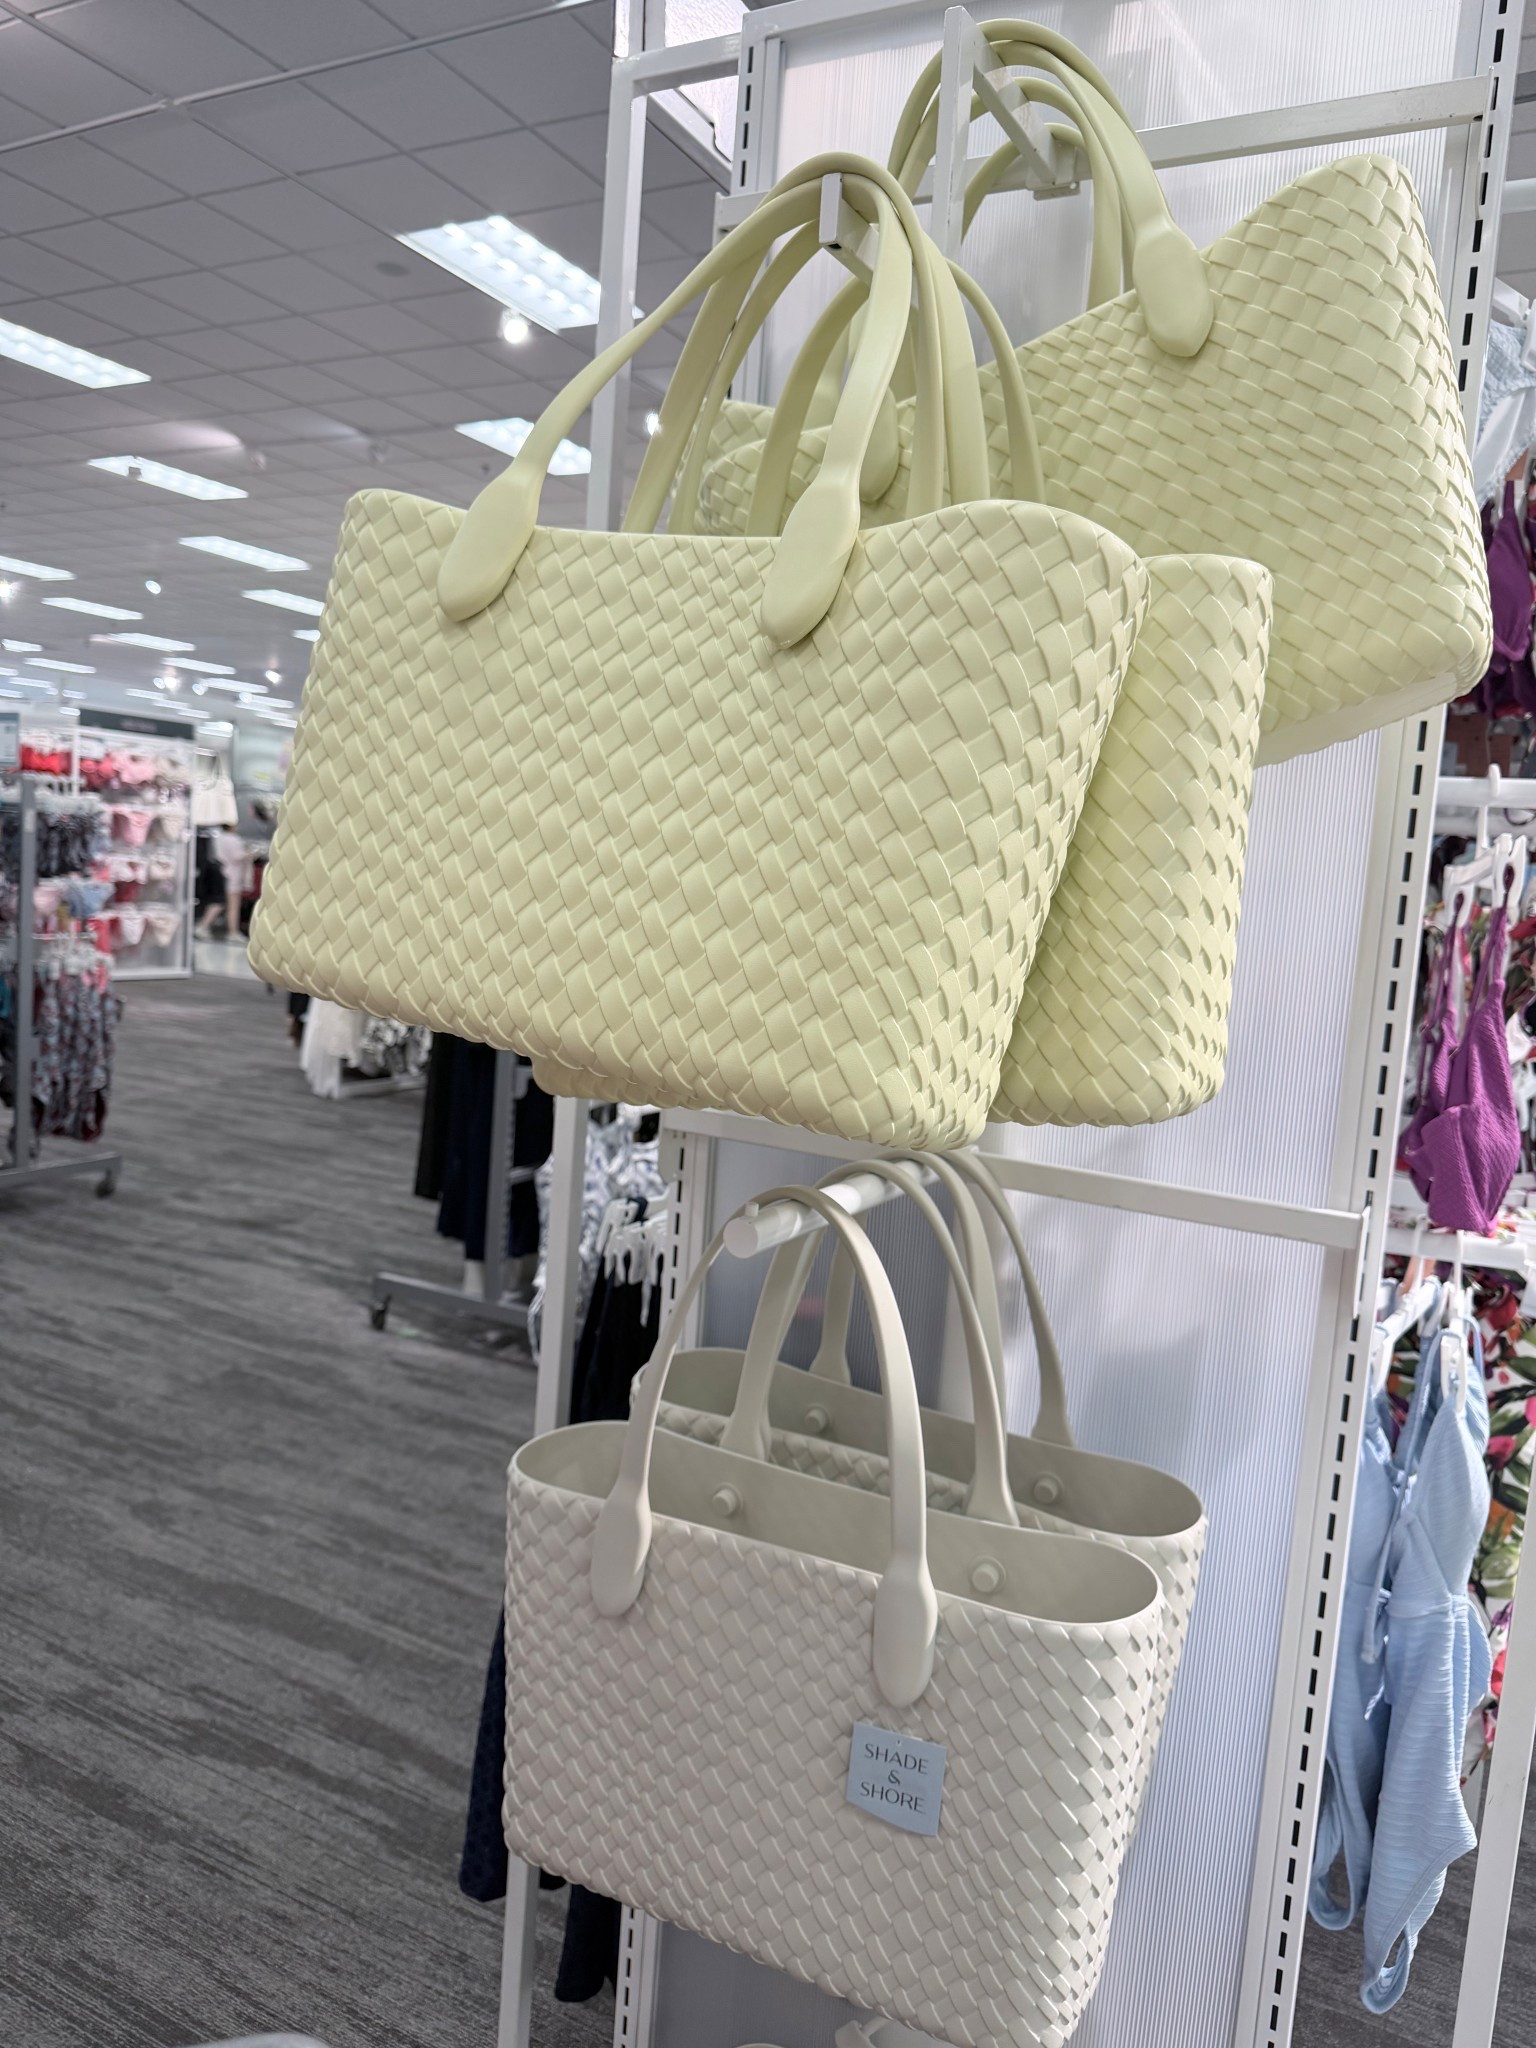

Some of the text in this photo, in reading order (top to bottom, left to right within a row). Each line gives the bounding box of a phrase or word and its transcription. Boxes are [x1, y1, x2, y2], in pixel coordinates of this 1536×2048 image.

[864, 1743, 929, 1775] SHADE
[888, 1769, 901, 1786] &
[860, 1781, 927, 1815] SHORE
